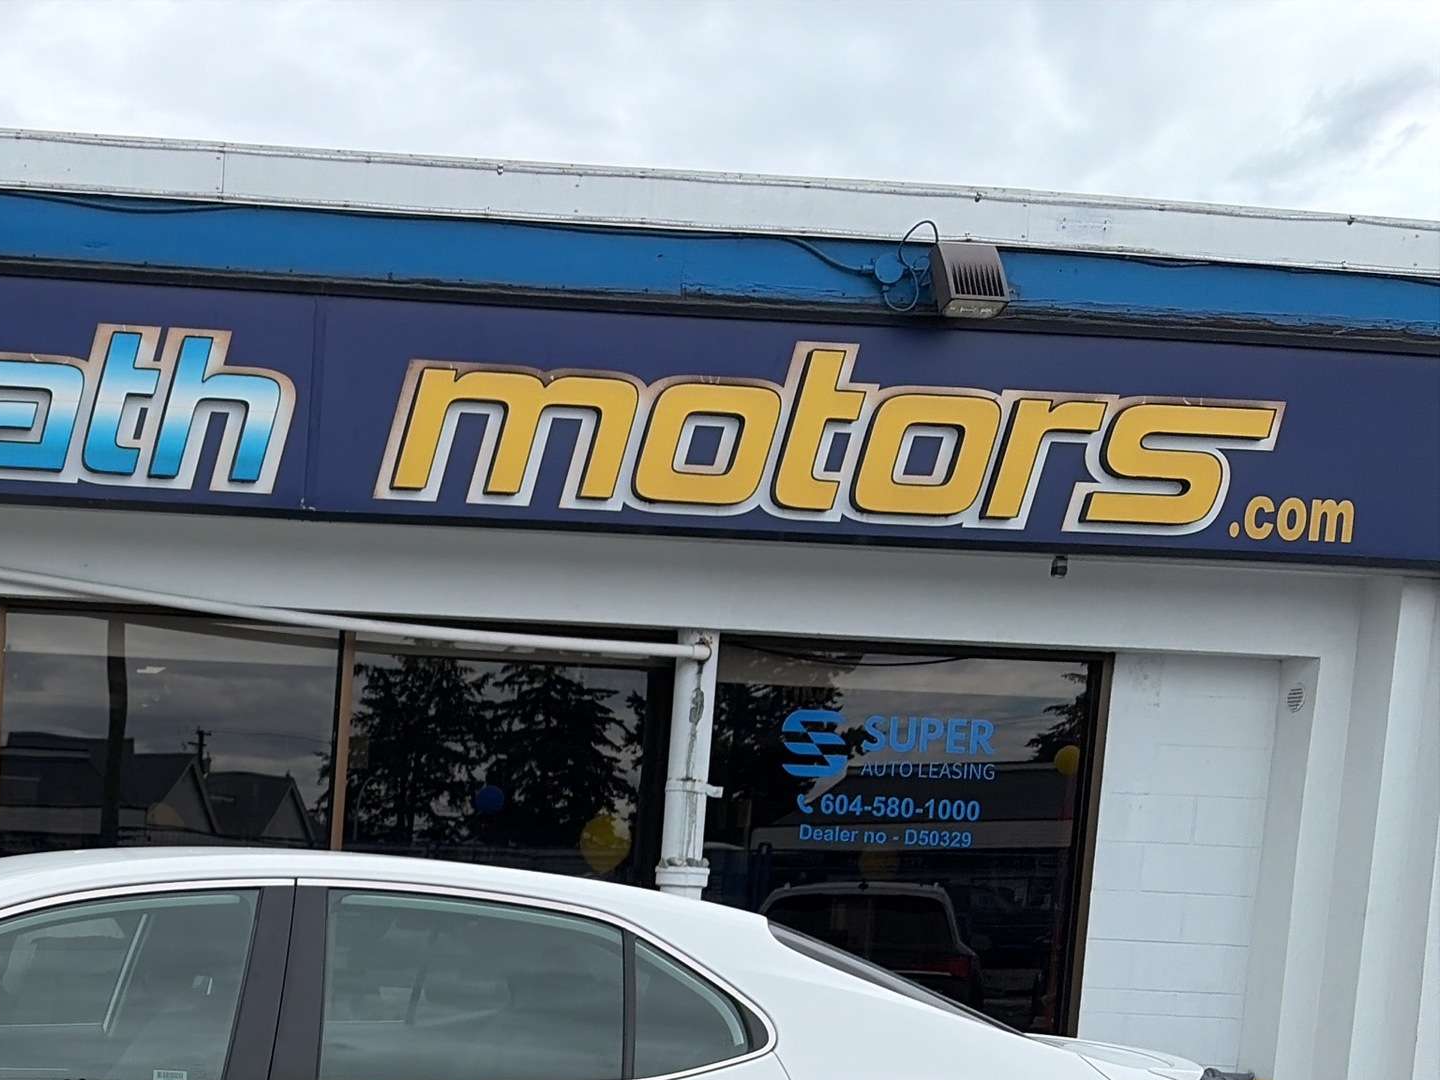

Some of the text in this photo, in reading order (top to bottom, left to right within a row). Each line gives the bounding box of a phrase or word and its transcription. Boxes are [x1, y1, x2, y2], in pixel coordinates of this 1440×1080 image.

[862, 714, 996, 756] SUPER
[861, 761, 996, 781] AUTO LEASING
[820, 793, 980, 822] 604-580-1000
[799, 824, 858, 843] Dealer
[863, 830, 887, 845] no
[904, 829, 972, 848] D50329
